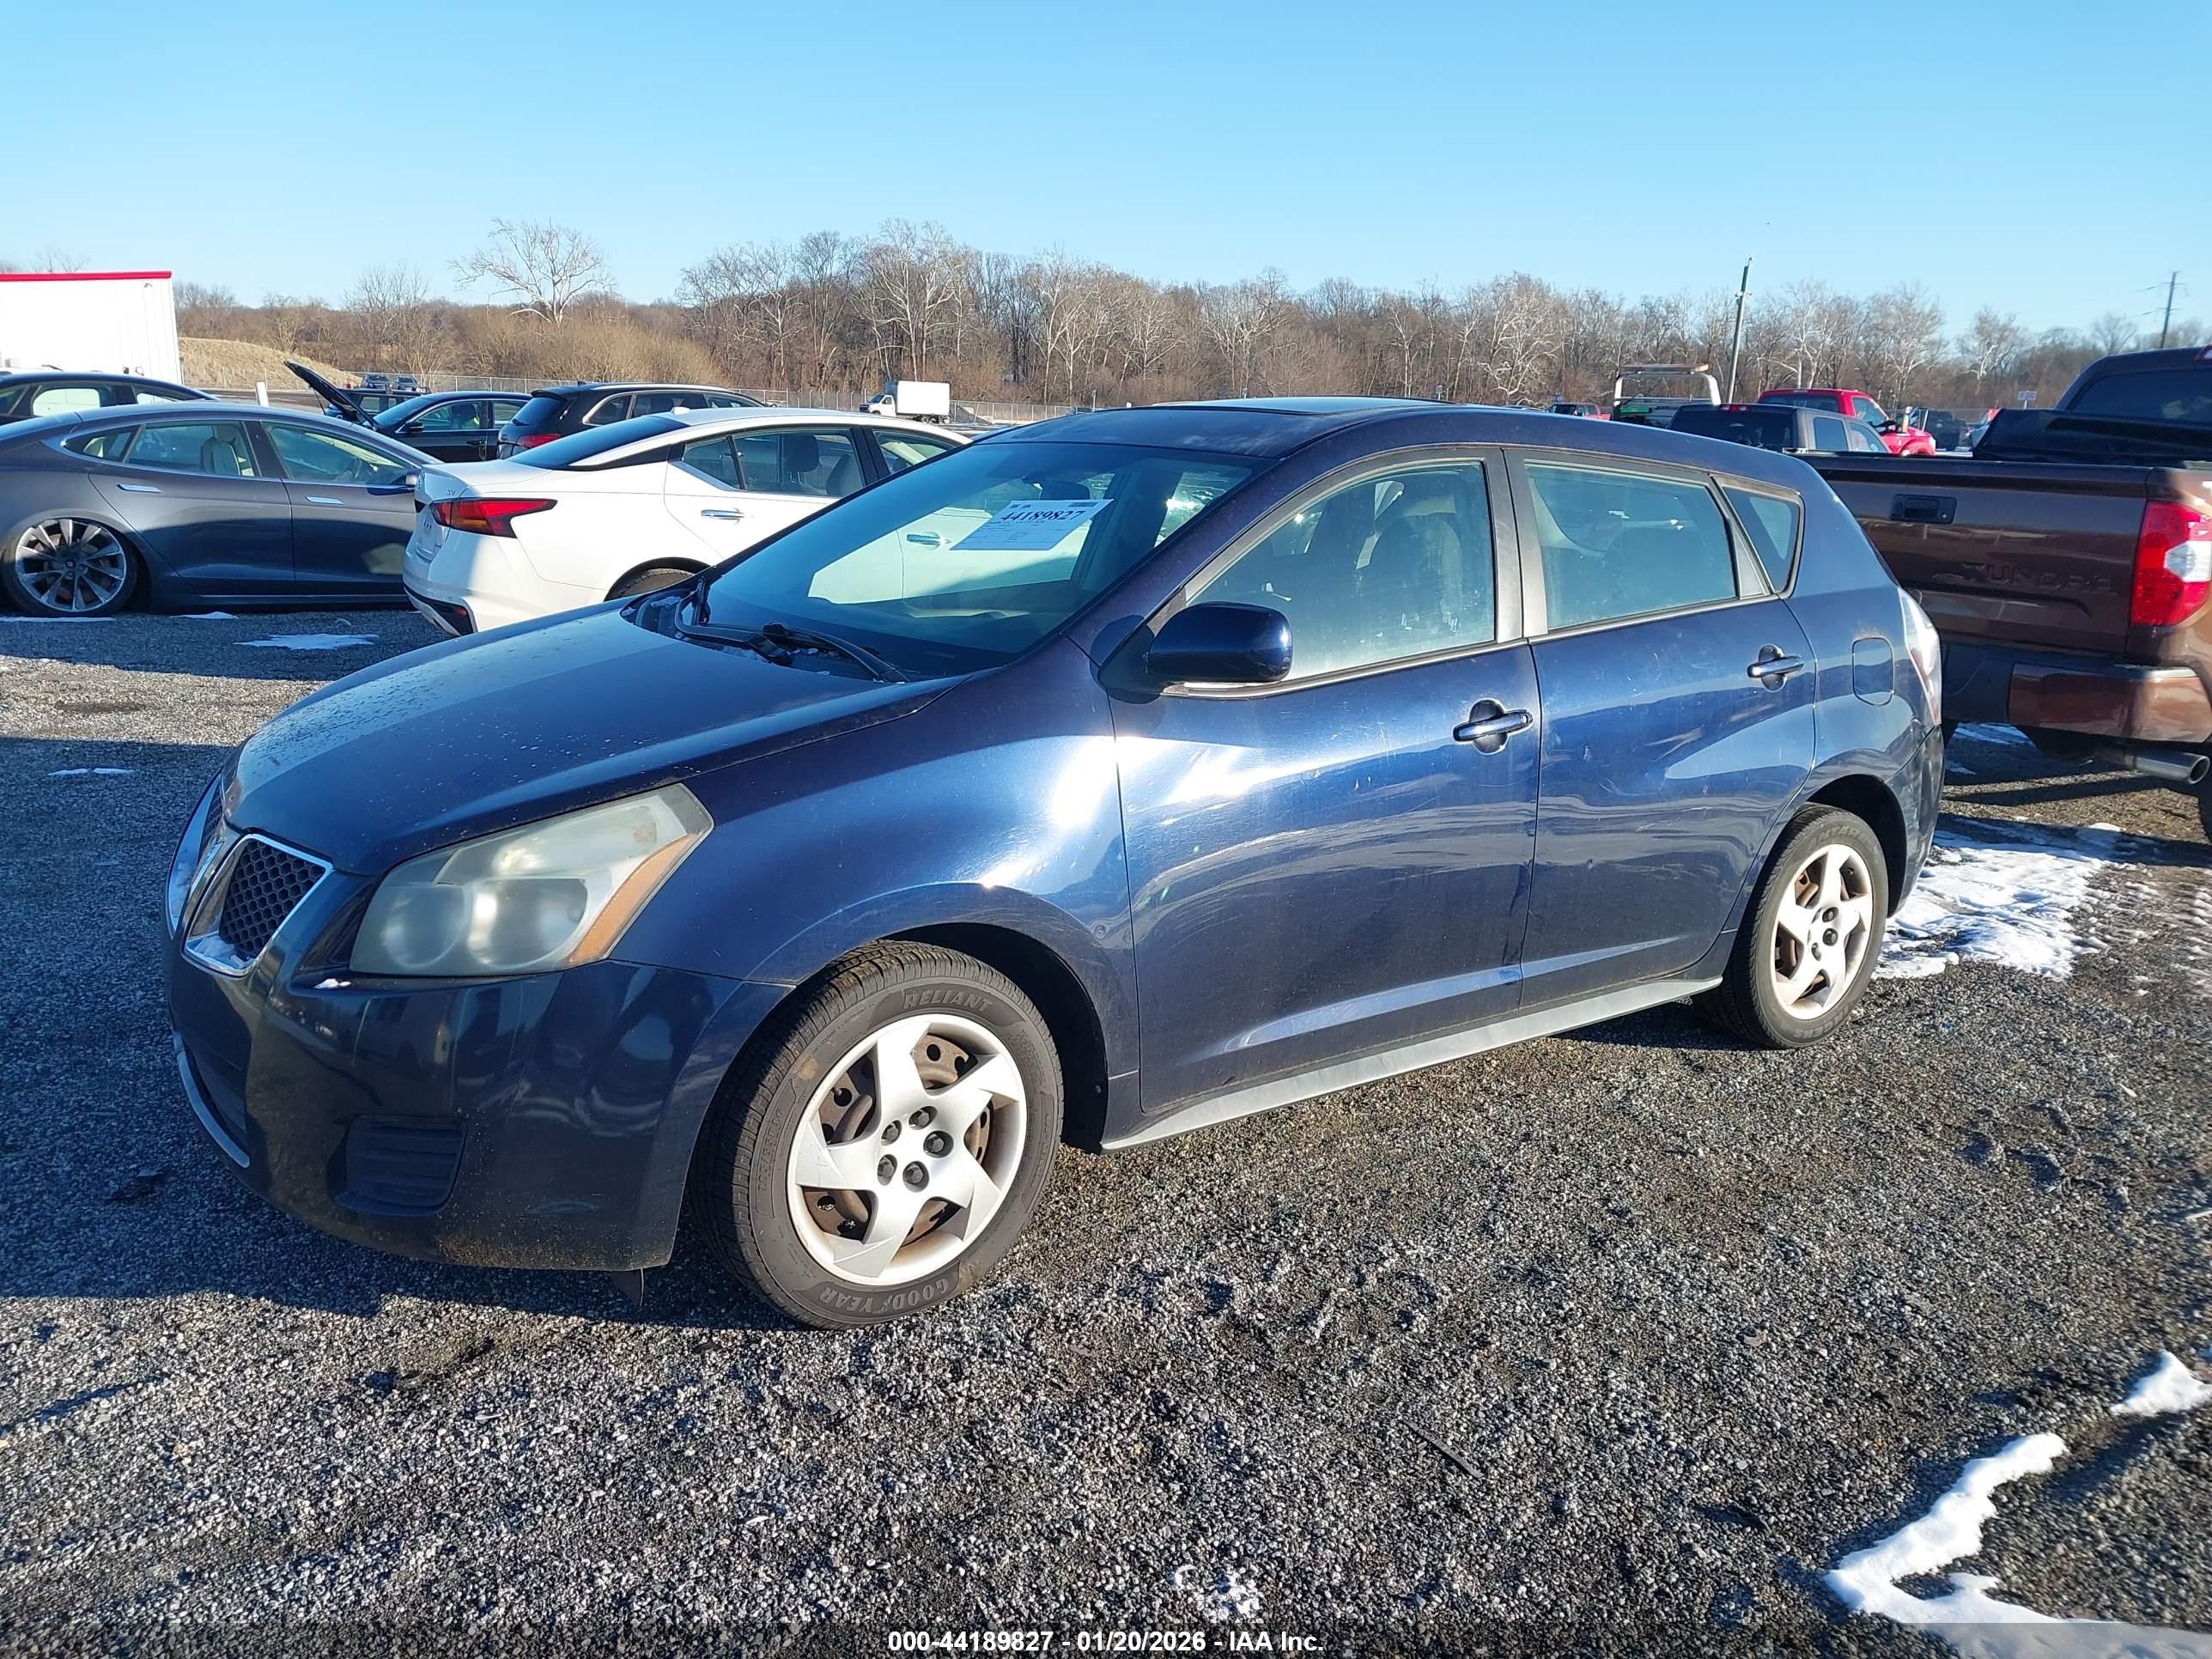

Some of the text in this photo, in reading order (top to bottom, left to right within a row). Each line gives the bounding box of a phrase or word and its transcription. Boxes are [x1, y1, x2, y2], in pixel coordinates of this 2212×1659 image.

[1000, 510, 1086, 521] 44189827
[1962, 563, 2118, 595] TUNDRA
[902, 988, 994, 1012] RELIANT
